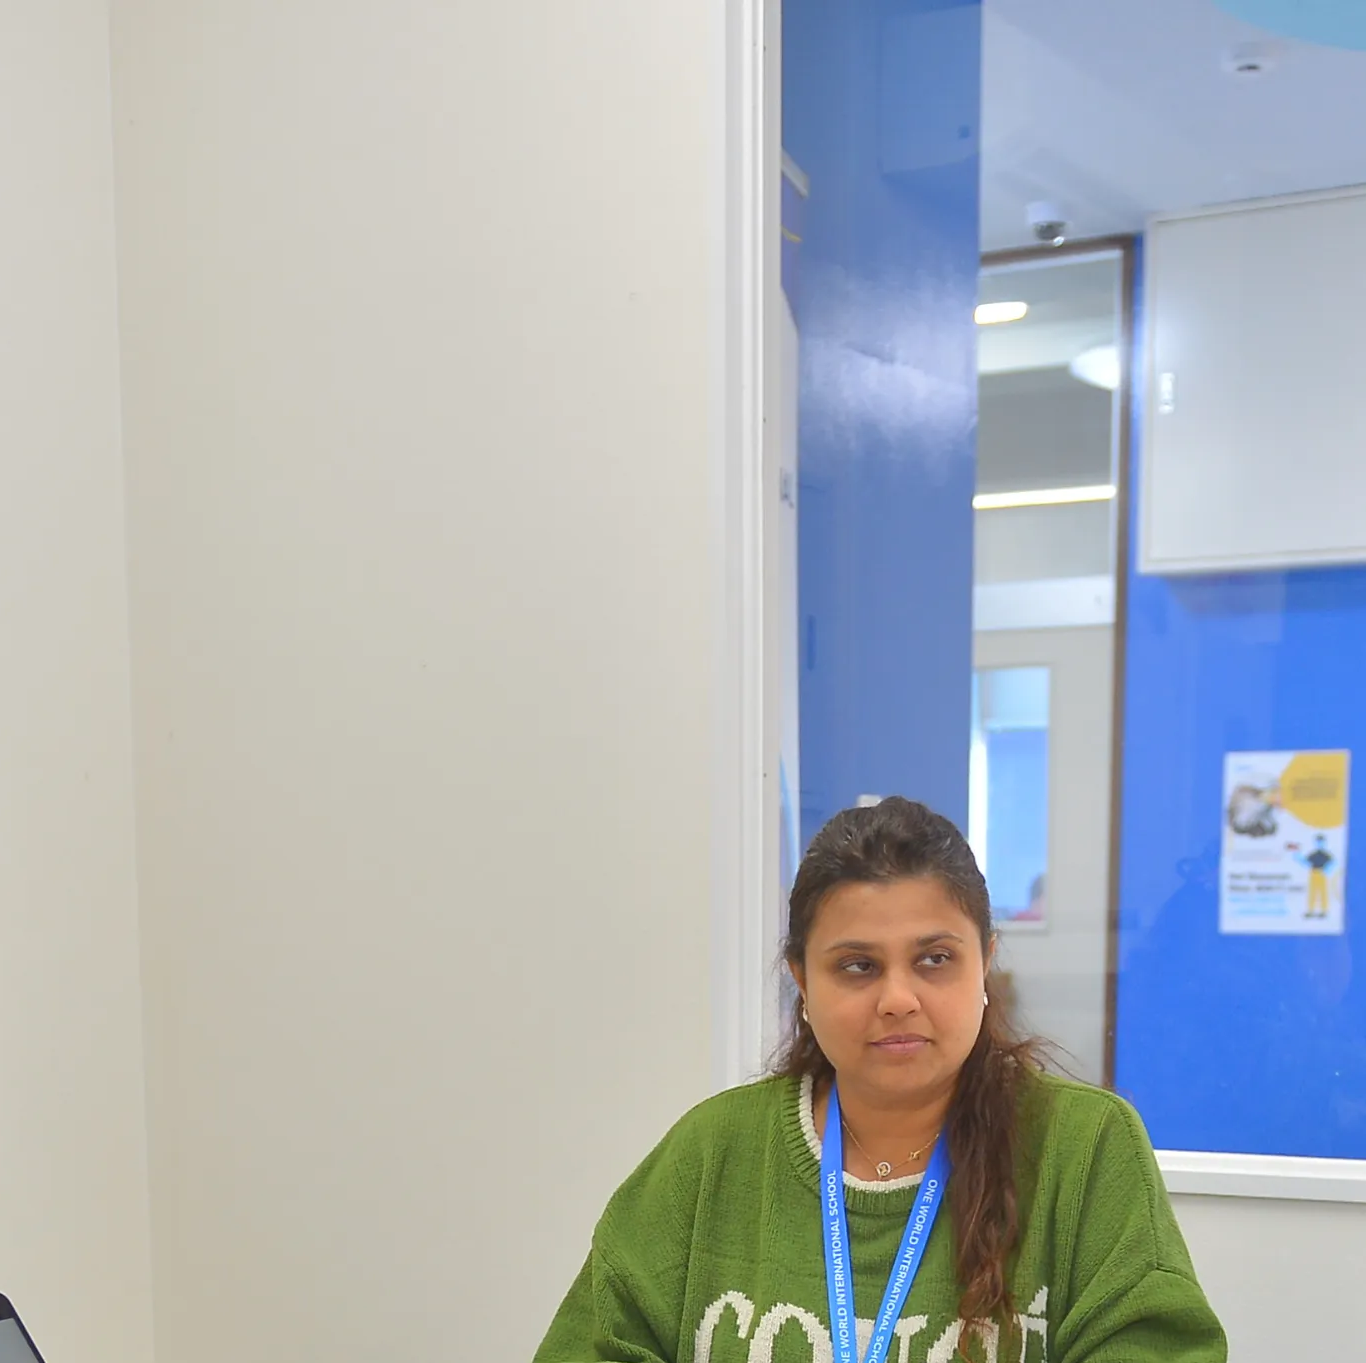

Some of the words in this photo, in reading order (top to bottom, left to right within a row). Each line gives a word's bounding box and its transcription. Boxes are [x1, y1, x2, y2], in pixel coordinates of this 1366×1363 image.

[827, 1170, 838, 1216] SCHOOL
[922, 1179, 938, 1204] ONE
[909, 1205, 931, 1245] WORLD
[831, 1218, 847, 1305] INTERNATIONAL
[879, 1246, 915, 1333] INTERNATIONAL
[837, 1307, 849, 1349] WORLD
